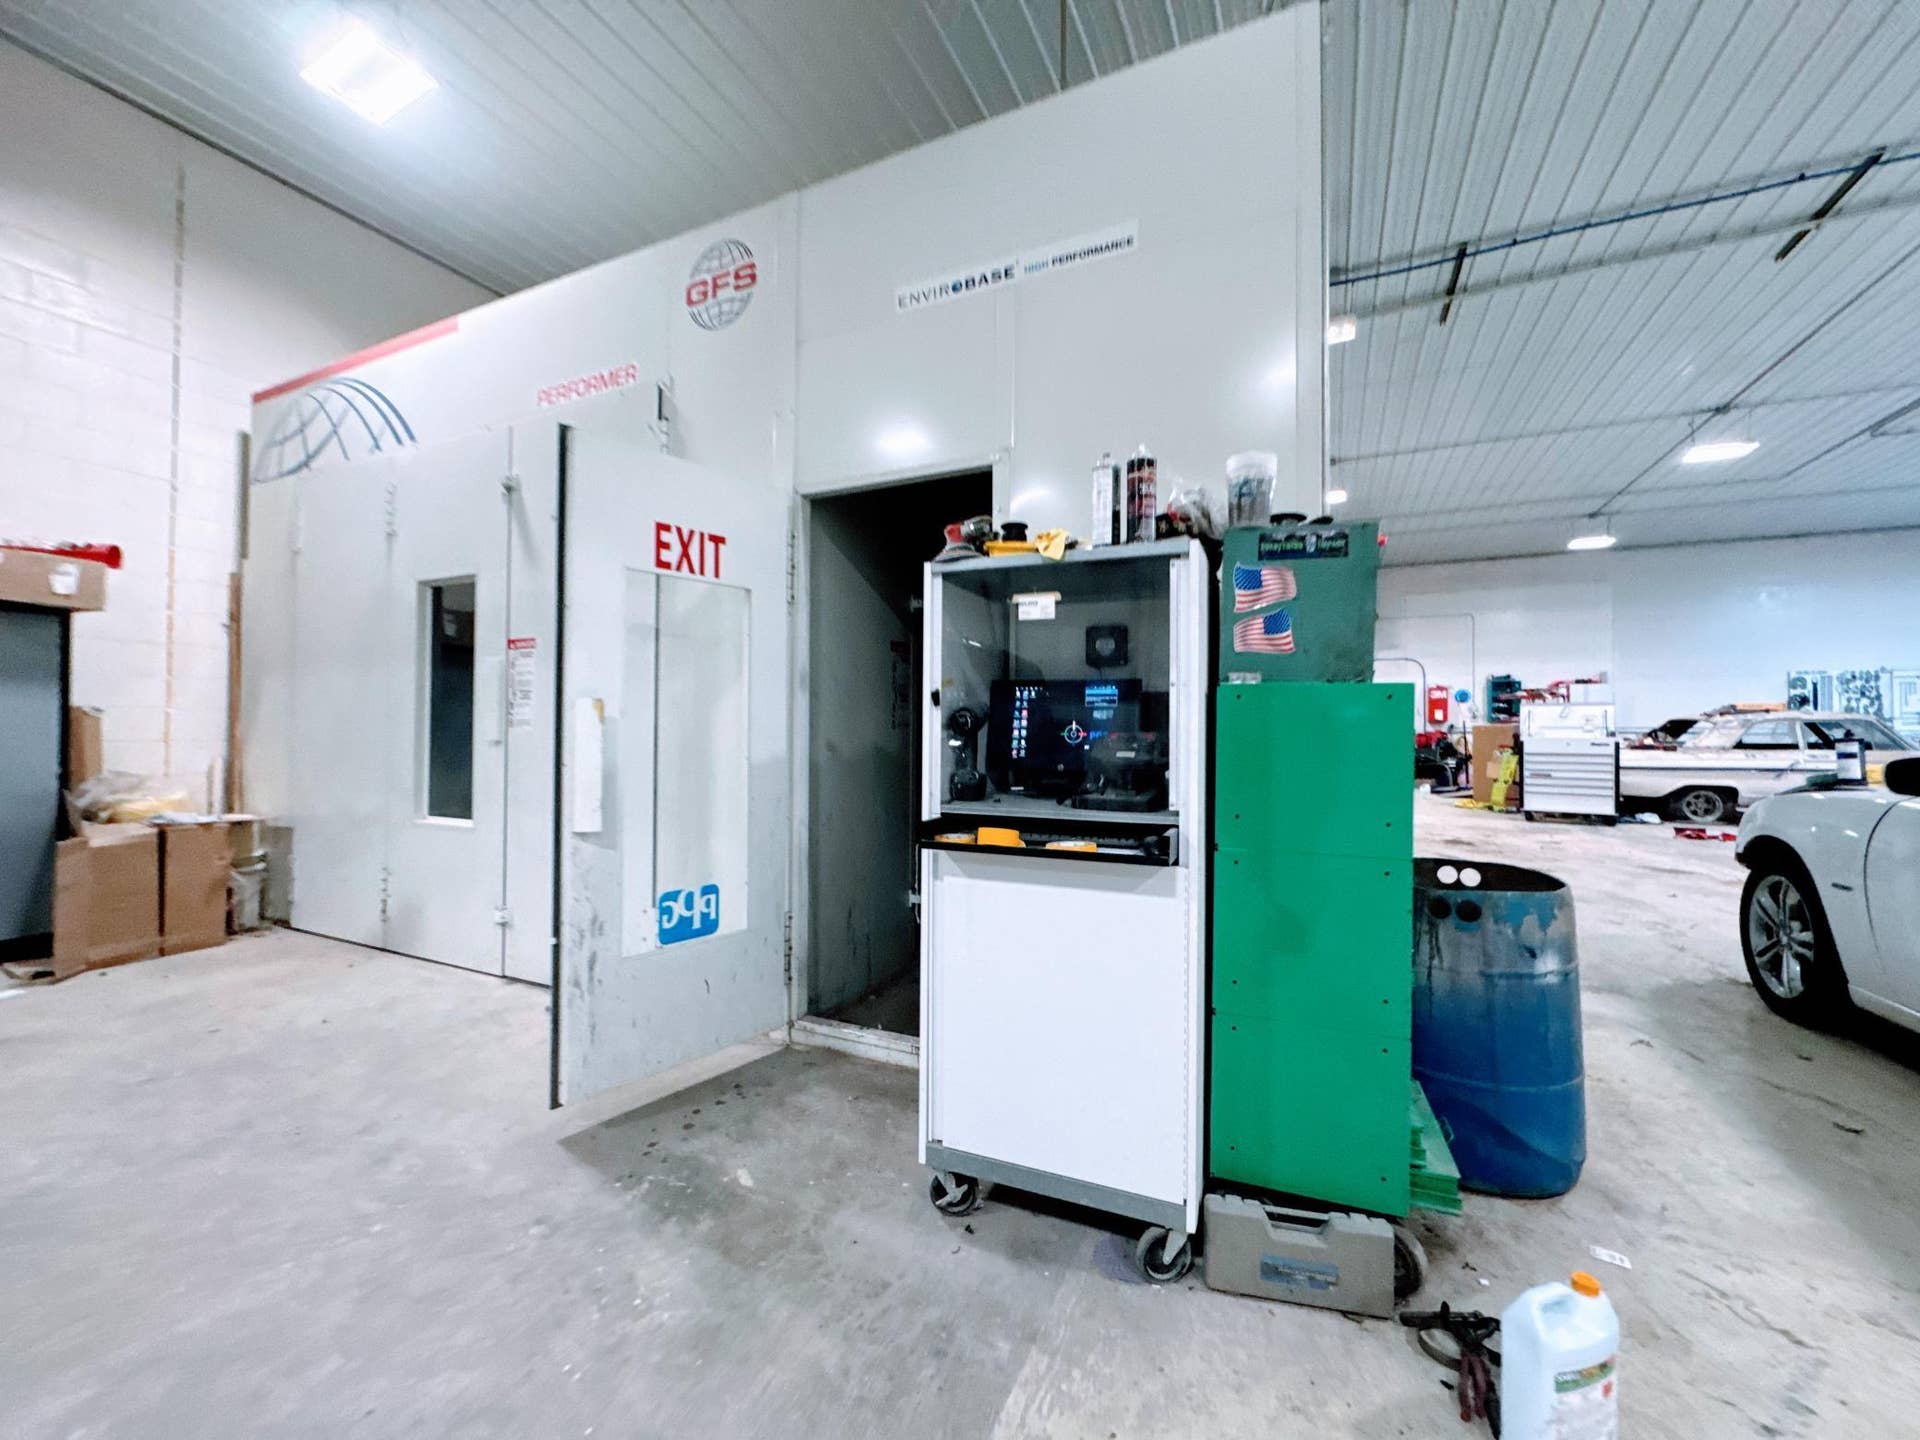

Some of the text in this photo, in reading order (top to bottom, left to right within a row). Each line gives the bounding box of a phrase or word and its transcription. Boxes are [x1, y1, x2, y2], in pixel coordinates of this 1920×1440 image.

[685, 262, 757, 307] GFS
[897, 264, 1015, 309] ENVIROBASE
[1051, 235, 1135, 268] PERFORMANCE
[537, 363, 639, 406] PERFORMER
[655, 522, 727, 579] EXIT
